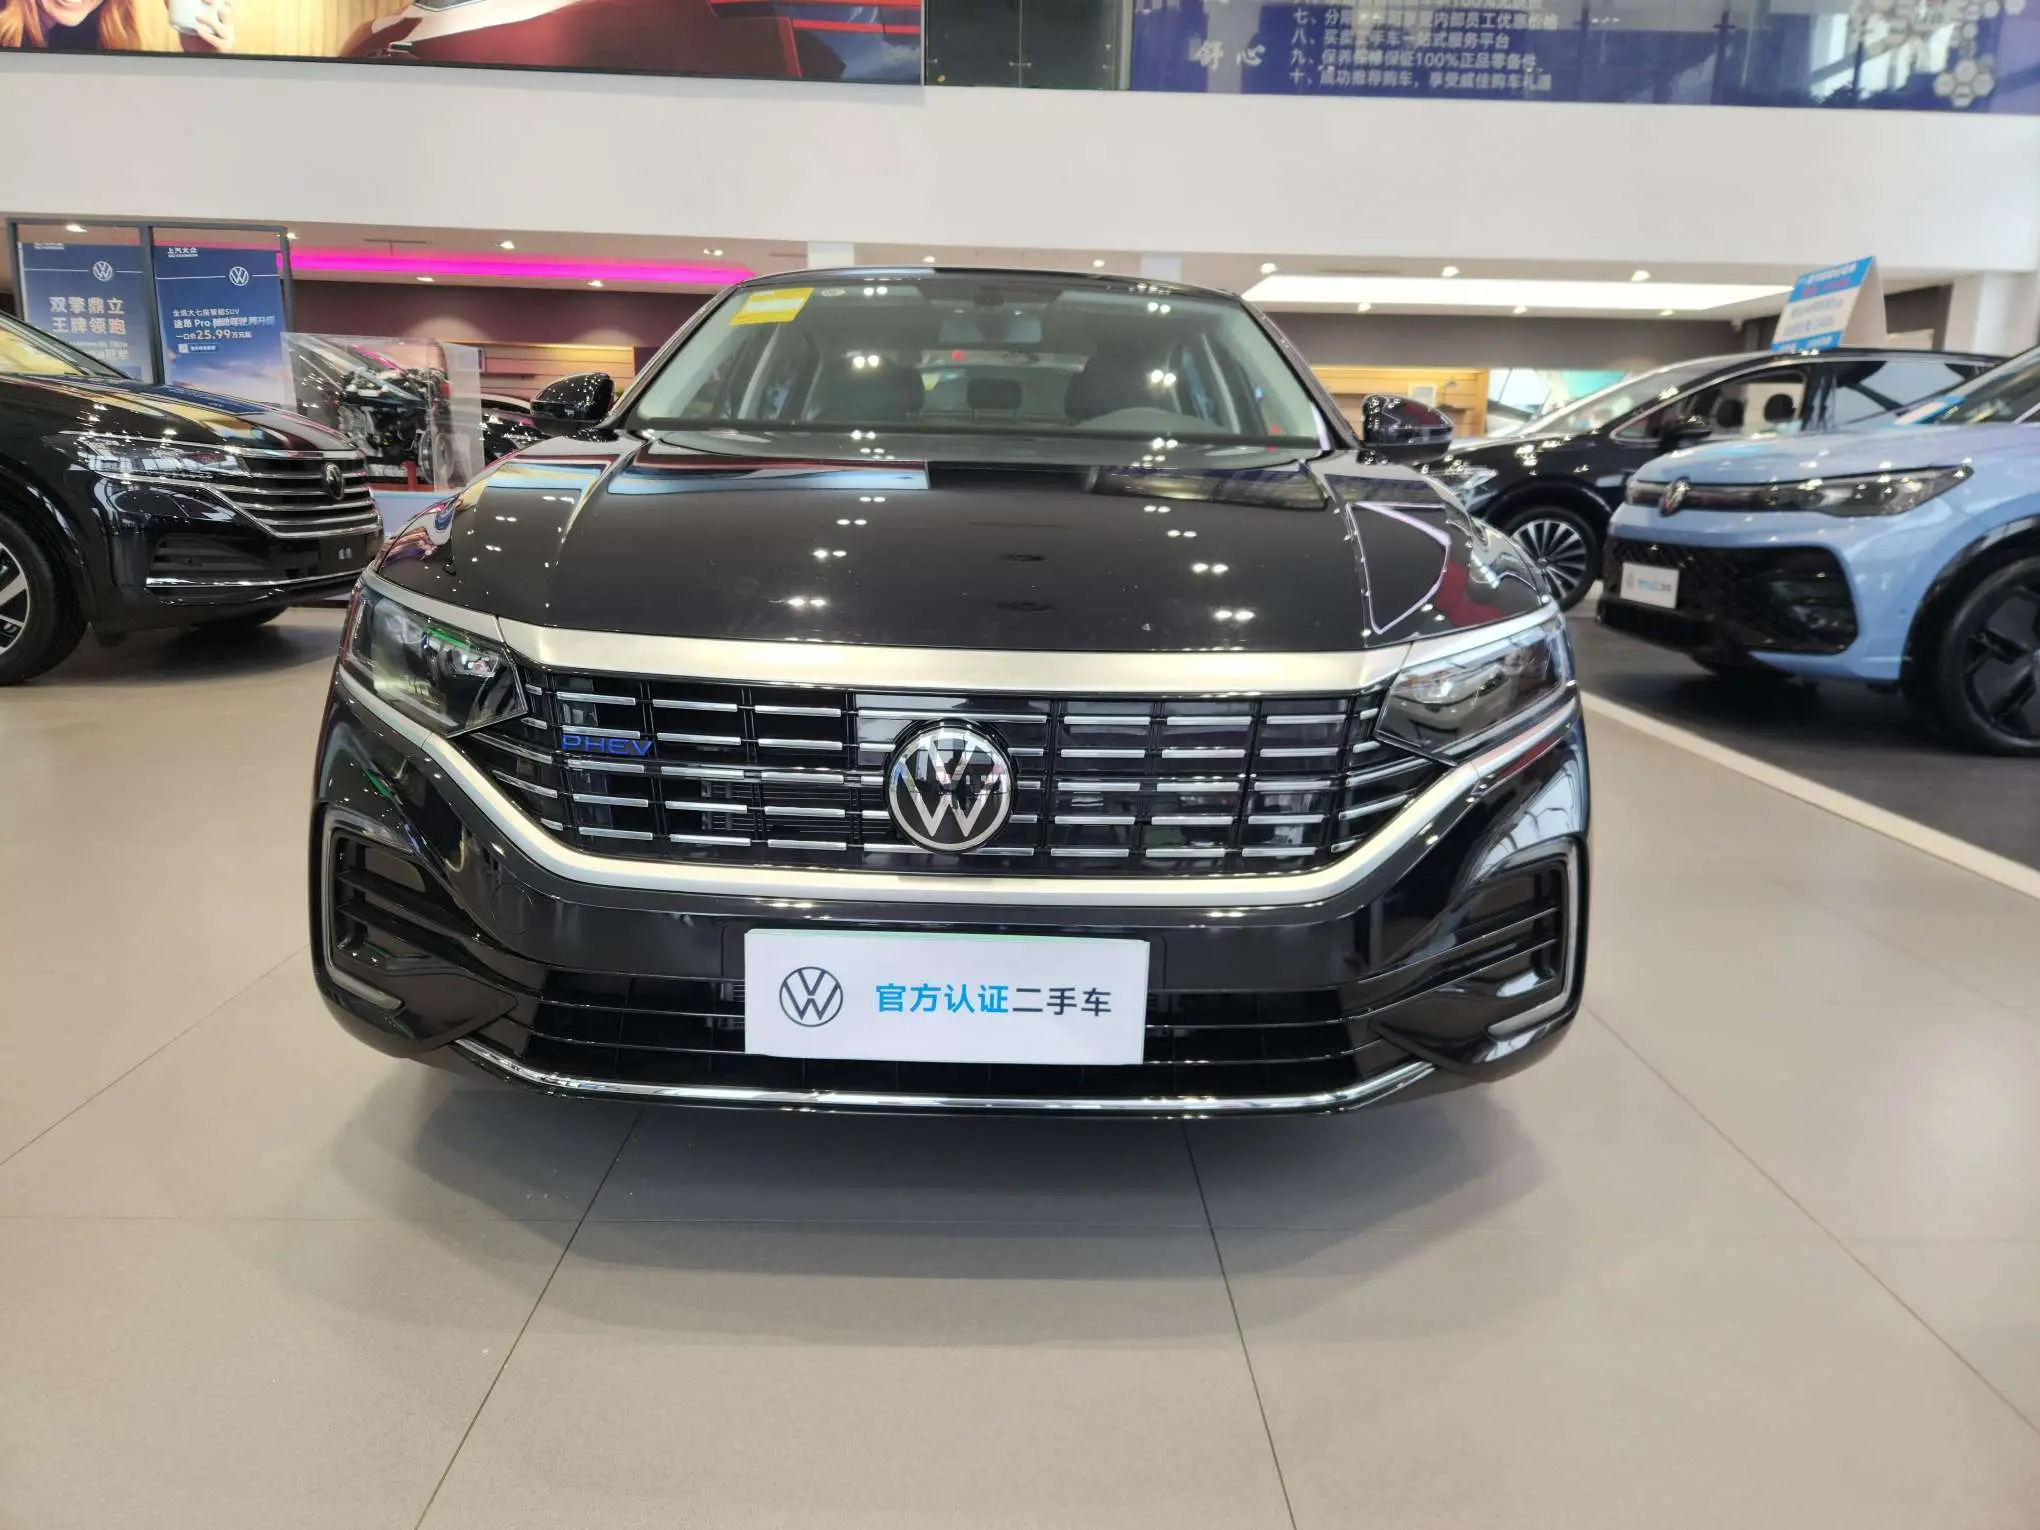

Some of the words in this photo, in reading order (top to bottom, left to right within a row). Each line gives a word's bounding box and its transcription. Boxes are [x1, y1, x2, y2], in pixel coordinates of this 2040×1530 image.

[562, 735, 652, 756] PHEV
[875, 983, 1112, 1017] 官方认证二手车
